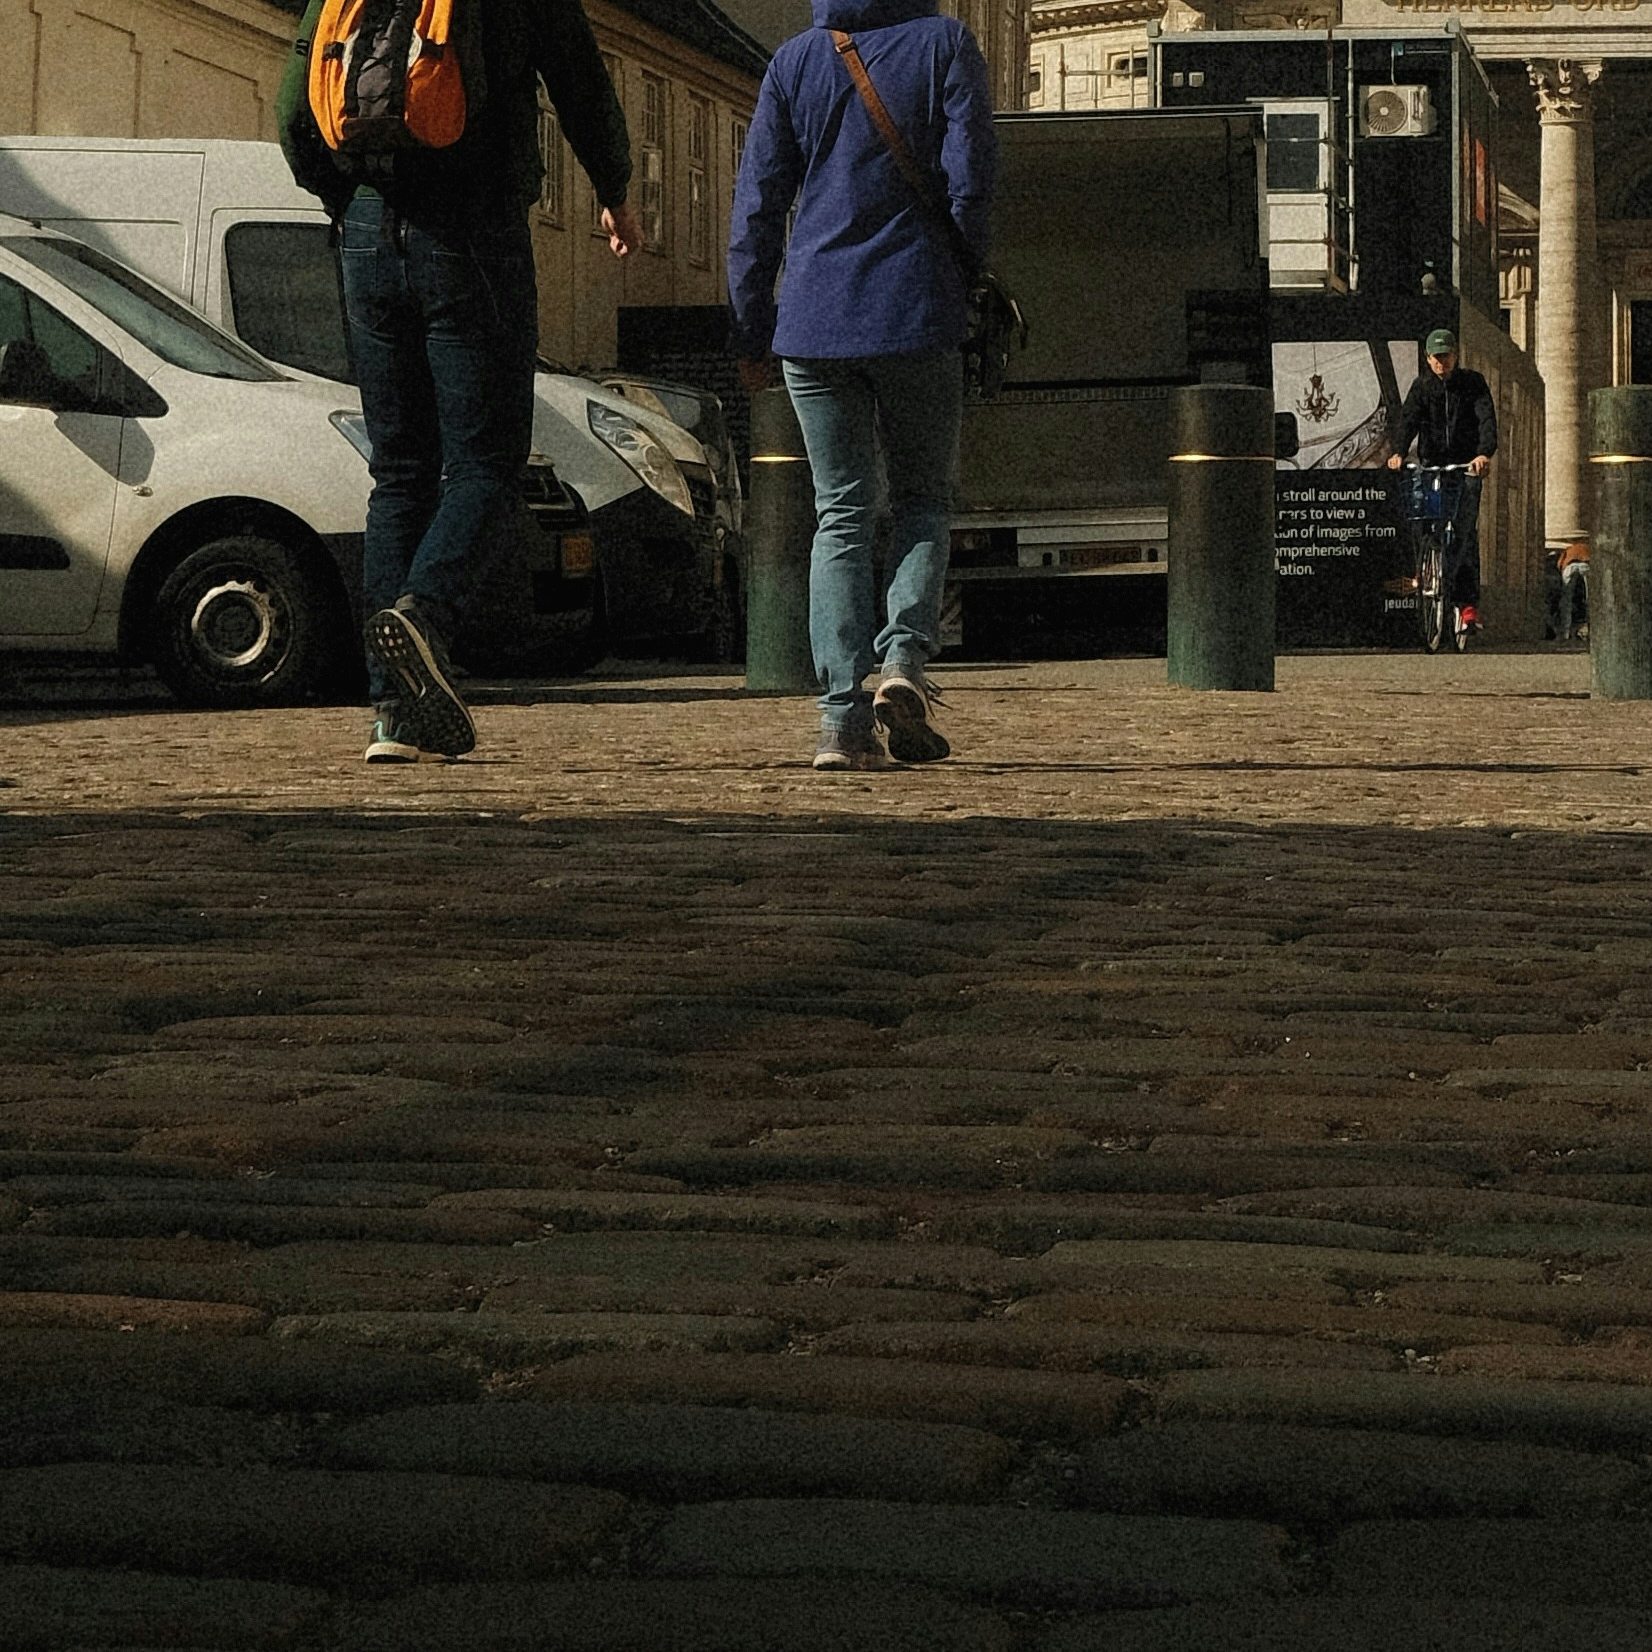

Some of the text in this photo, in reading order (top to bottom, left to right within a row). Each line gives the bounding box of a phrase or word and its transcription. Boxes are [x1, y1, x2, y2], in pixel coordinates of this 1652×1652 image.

[1283, 488, 1315, 502] stroll
[1318, 487, 1363, 502] around
[1366, 487, 1387, 501] the
[1310, 508, 1323, 520] to
[1326, 506, 1355, 520] view
[1358, 508, 1366, 519] a
[1301, 524, 1315, 538] of
[1365, 524, 1396, 538] from
